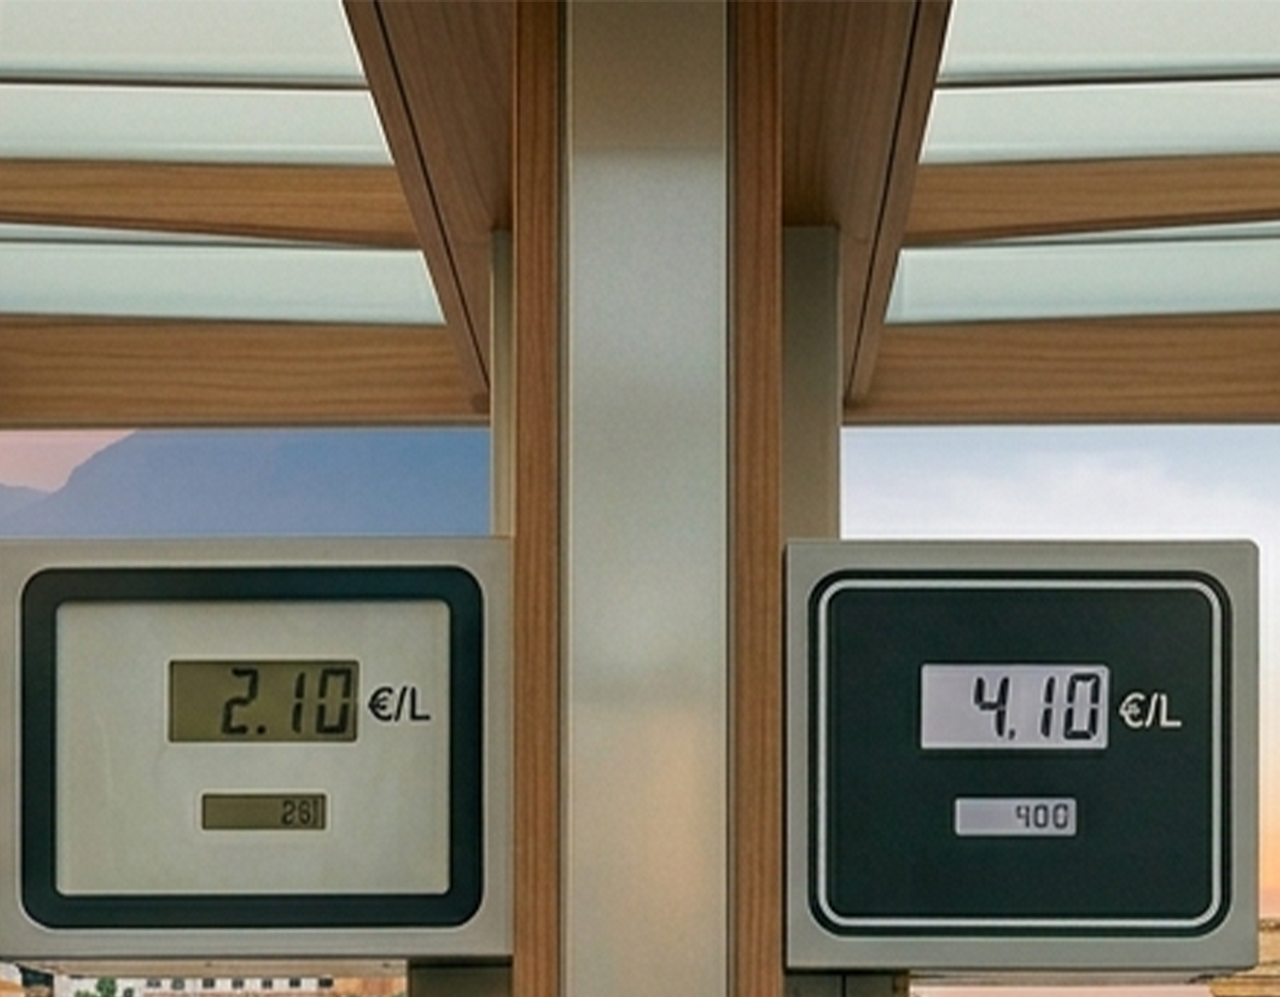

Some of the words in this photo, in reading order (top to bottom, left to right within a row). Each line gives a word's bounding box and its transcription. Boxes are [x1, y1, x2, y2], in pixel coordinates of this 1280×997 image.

[222, 668, 352, 734] 2.10
[368, 686, 431, 722] €/L
[1119, 692, 1182, 728] €/L
